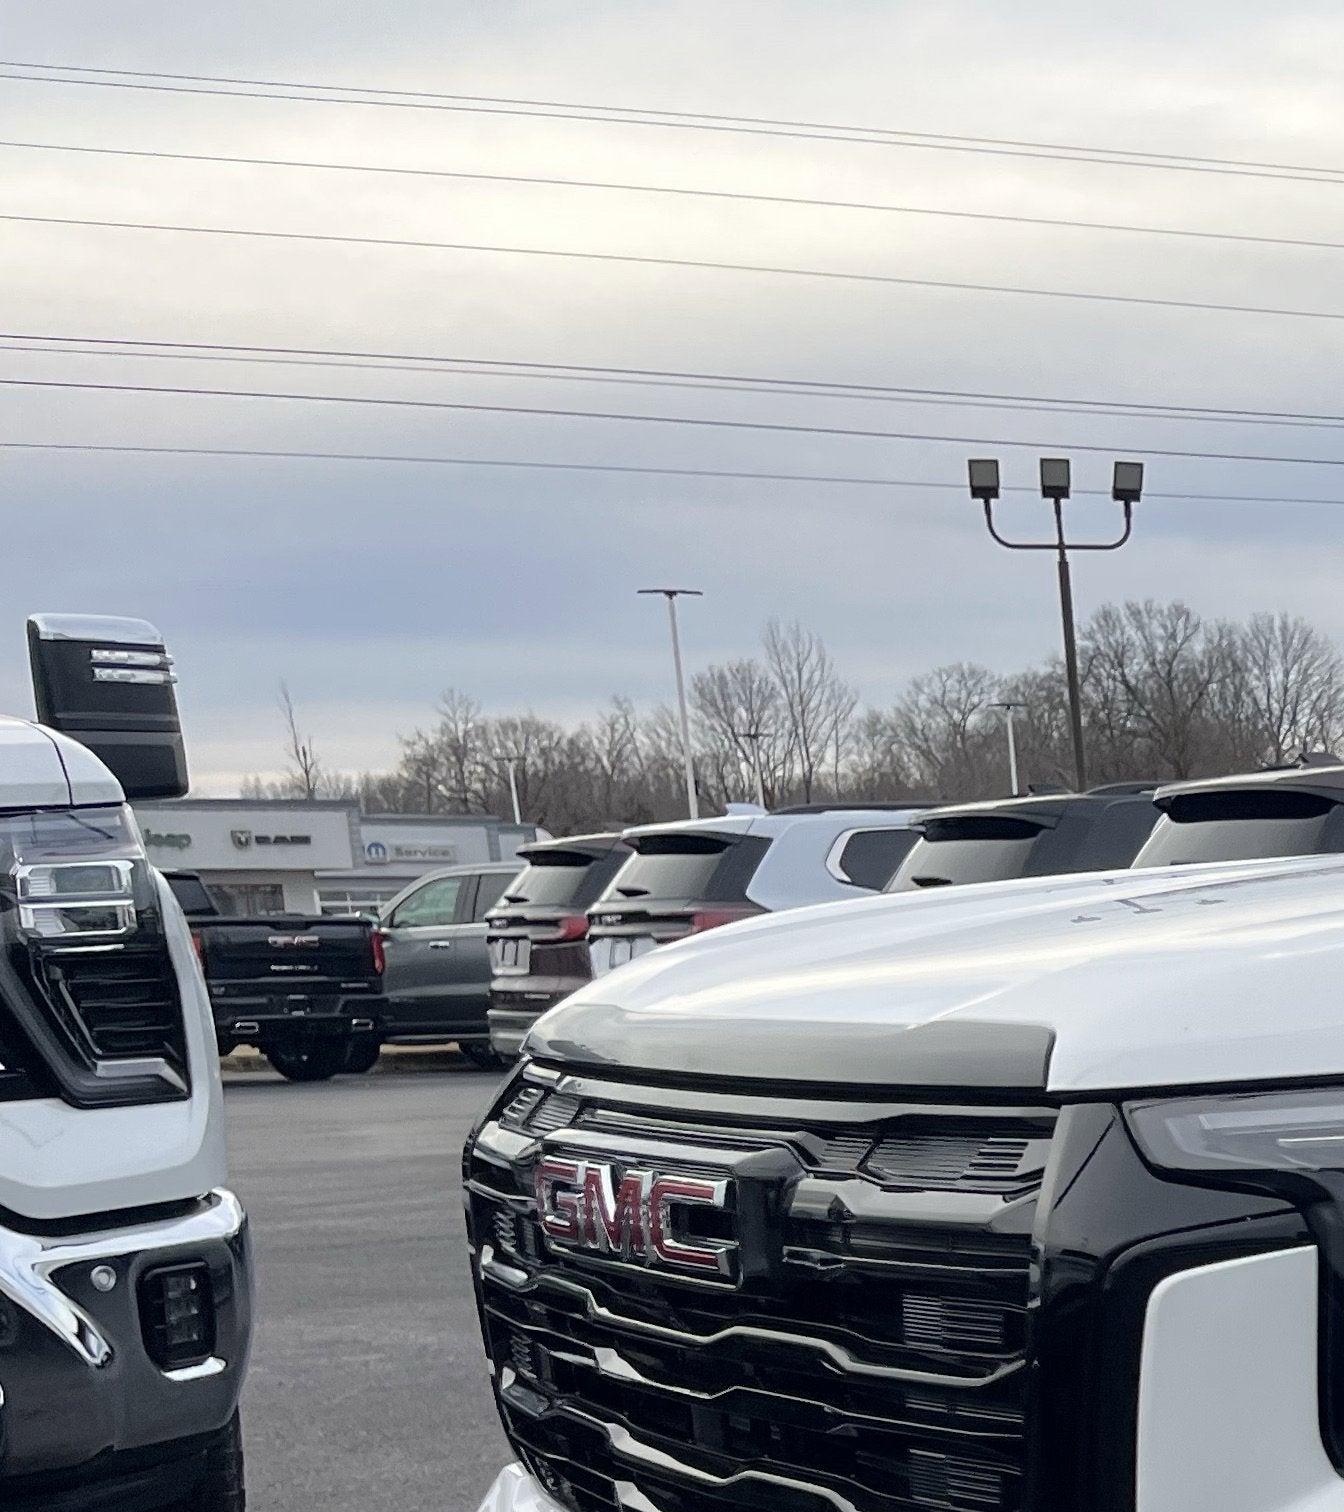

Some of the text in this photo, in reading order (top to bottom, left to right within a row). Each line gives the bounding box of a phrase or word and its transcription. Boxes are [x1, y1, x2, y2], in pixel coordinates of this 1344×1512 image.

[255, 835, 312, 846] RAM
[395, 846, 450, 858] Service
[534, 1155, 731, 1274] GMC
